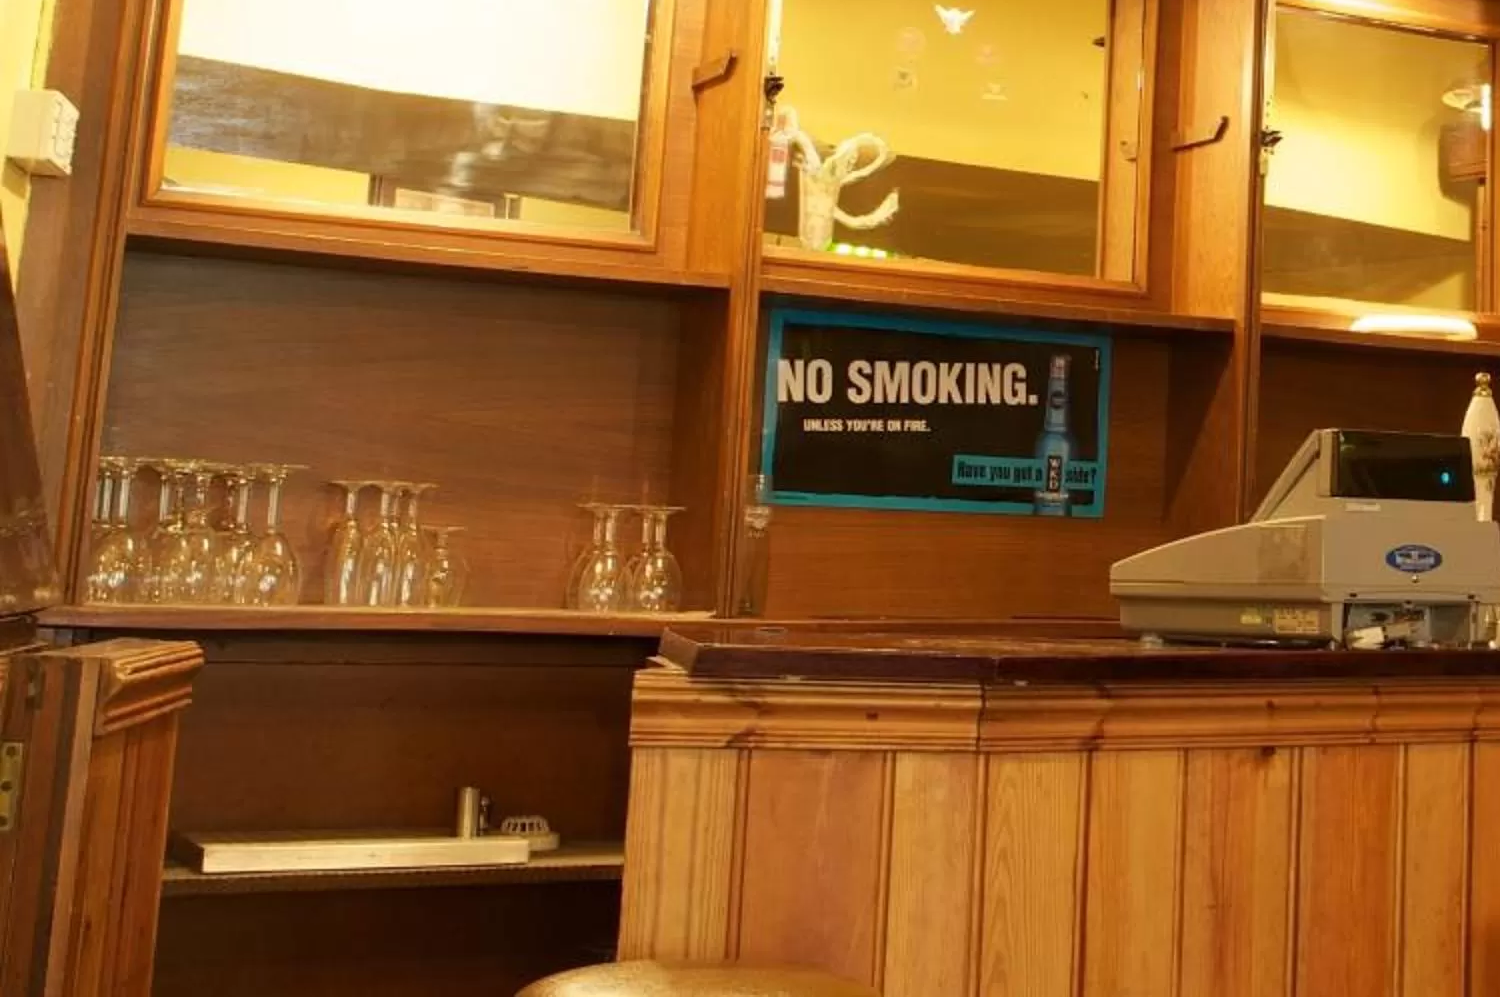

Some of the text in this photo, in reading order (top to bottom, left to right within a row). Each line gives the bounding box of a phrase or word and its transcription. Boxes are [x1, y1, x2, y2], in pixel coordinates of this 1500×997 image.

[777, 358, 1039, 405] NO SMOKING.
[803, 418, 931, 432] UNLESS YOU'RE ON FIRE.
[989, 465, 1011, 482] you
[1013, 466, 1033, 483] got
[1035, 468, 1043, 482] a
